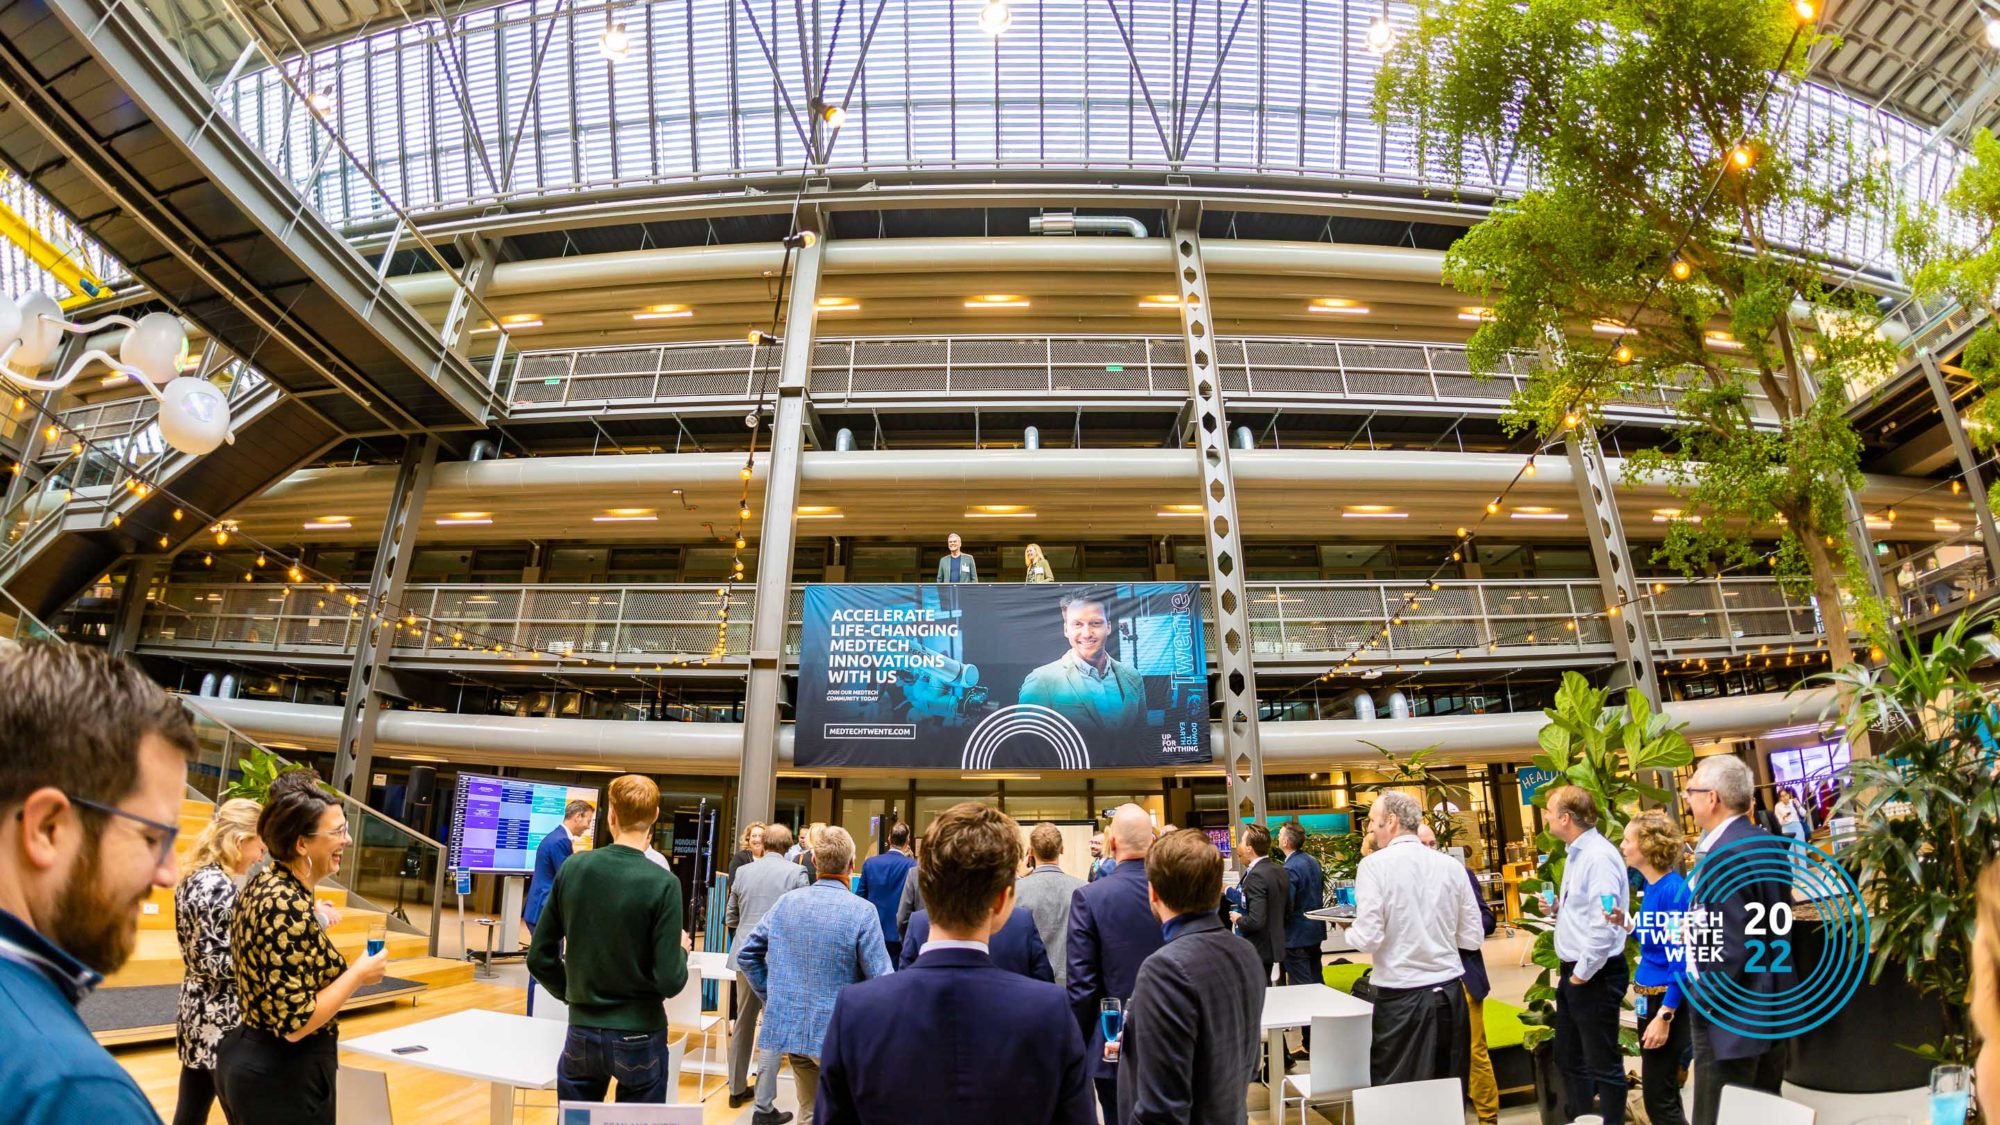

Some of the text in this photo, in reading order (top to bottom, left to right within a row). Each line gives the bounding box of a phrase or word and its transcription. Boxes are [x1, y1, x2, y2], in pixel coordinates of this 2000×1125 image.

[831, 609, 935, 622] ACCELERATE
[831, 624, 959, 637] LIFE-CHANGING
[829, 639, 909, 652] MEDTECH
[1171, 593, 1195, 690] Twente
[828, 654, 945, 668] INNOVATIONS
[828, 670, 898, 684] WITH US
[829, 727, 911, 736] MEDTECHTWENTE.COM
[1190, 722, 1198, 745] DOWN
[1186, 735, 1192, 746] TO
[1162, 745, 1199, 753] ANYTHING
